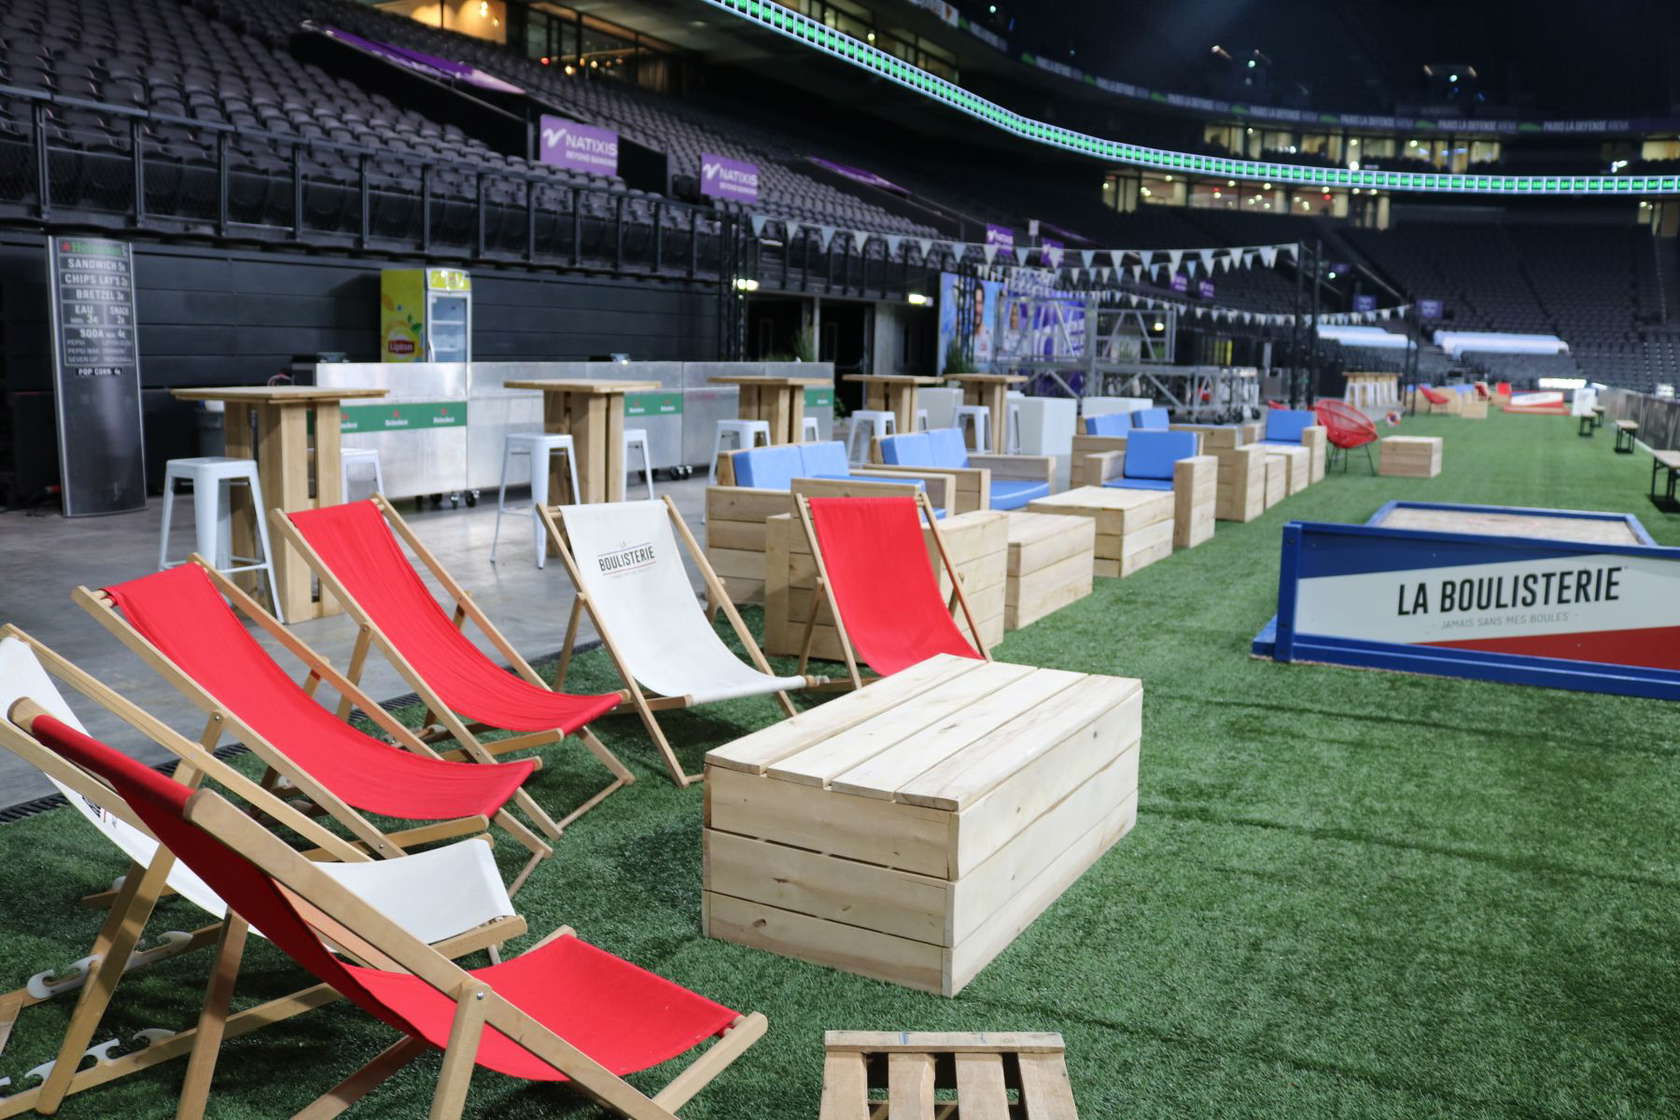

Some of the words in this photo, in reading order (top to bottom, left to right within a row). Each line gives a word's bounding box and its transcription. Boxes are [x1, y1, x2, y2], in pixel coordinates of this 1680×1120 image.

[566, 134, 617, 156] NATIXIS
[720, 168, 758, 187] NATIXIS
[67, 258, 117, 271] SANDWICH
[65, 274, 97, 284] CHIPS
[75, 289, 115, 300] BRETZEL
[75, 305, 94, 315] EAU
[80, 329, 105, 338] SODA
[598, 545, 655, 572] BOULISTERIE
[1397, 582, 1429, 616] LA
[1439, 566, 1622, 613] BOULISTERIE
[1441, 619, 1474, 630] JAMAIS
[1477, 617, 1503, 627] SANS
[1506, 615, 1527, 625] MES
[1530, 612, 1569, 624] BOULES
